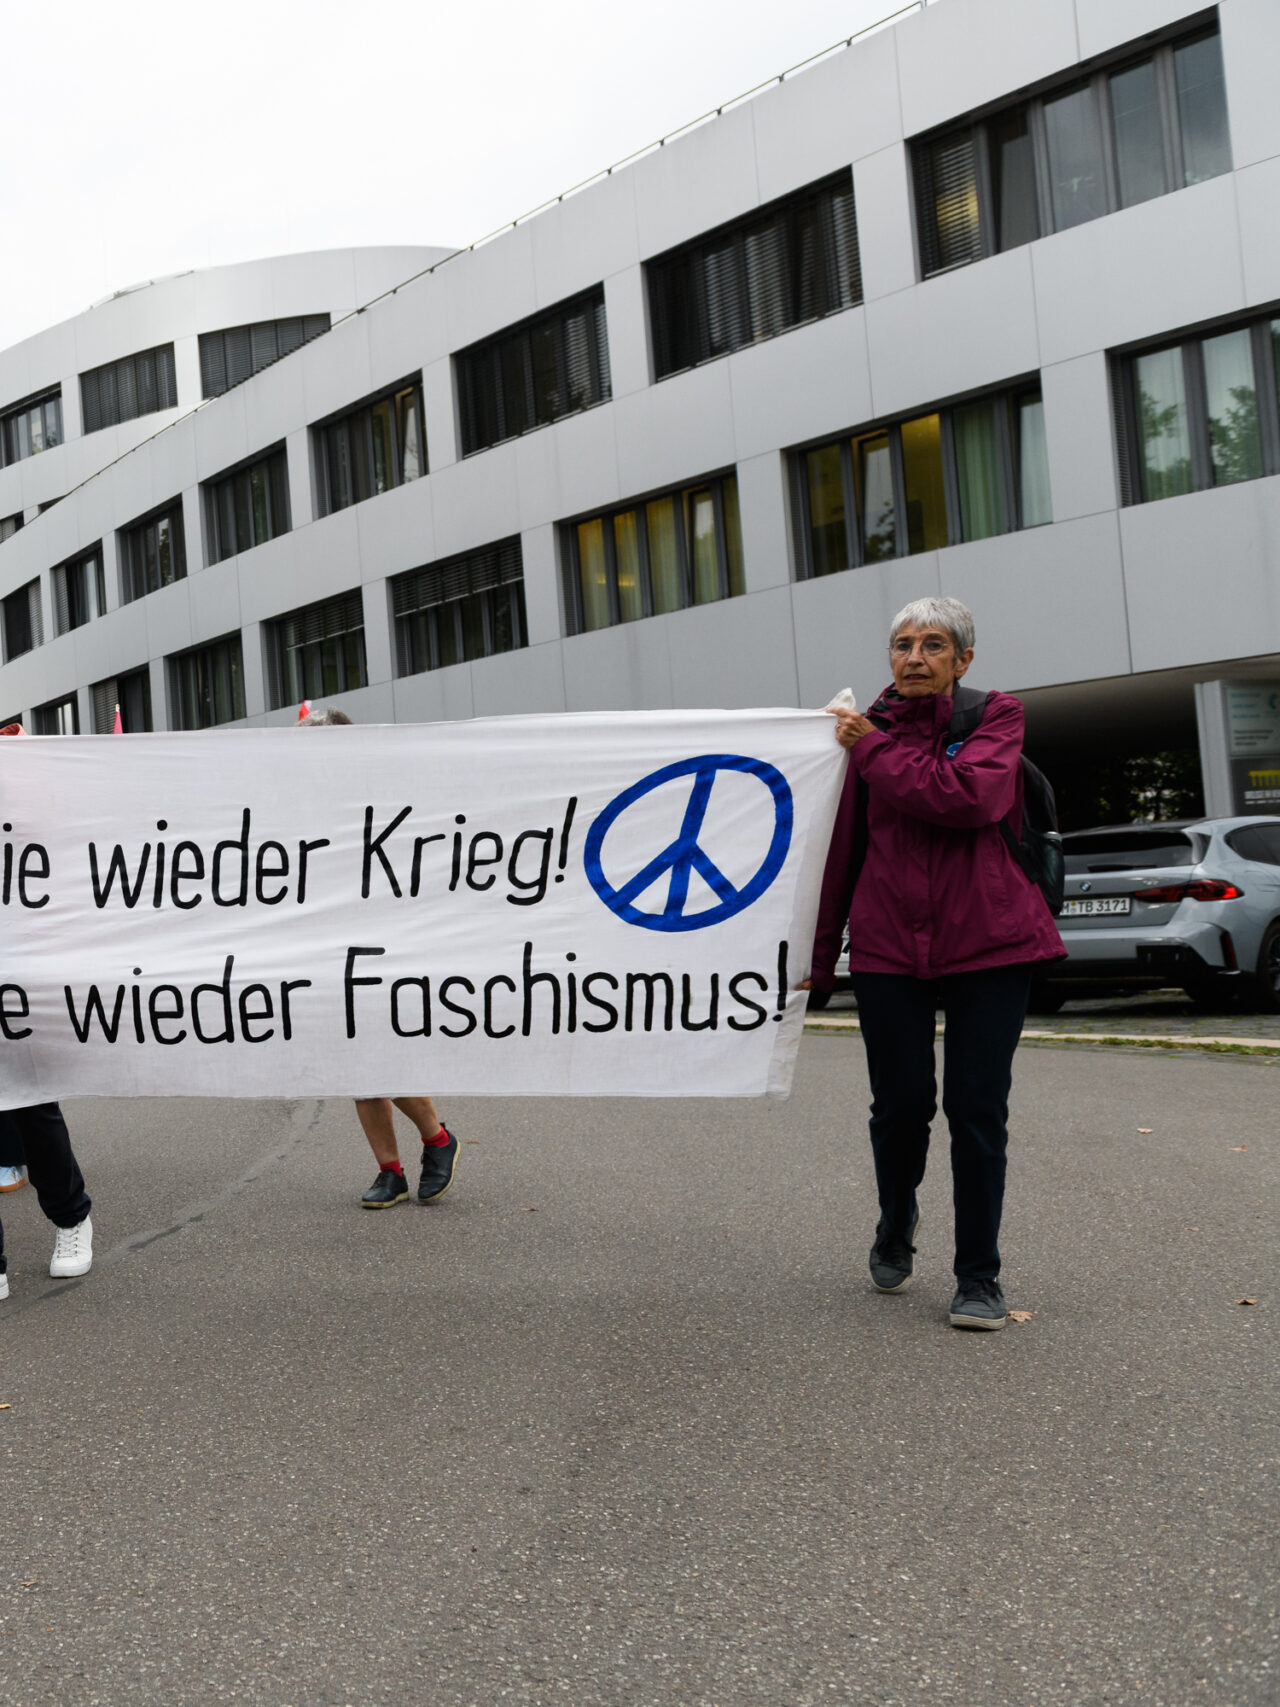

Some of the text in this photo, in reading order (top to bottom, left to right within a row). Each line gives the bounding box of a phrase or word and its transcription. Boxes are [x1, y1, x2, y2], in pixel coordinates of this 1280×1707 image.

[89, 808, 330, 909] wieder
[362, 797, 578, 906] Krieg!
[1078, 901, 1093, 913] TB
[1096, 899, 1128, 912] 3171
[64, 955, 312, 1045] wieder
[345, 941, 789, 1040] Faschismus!
